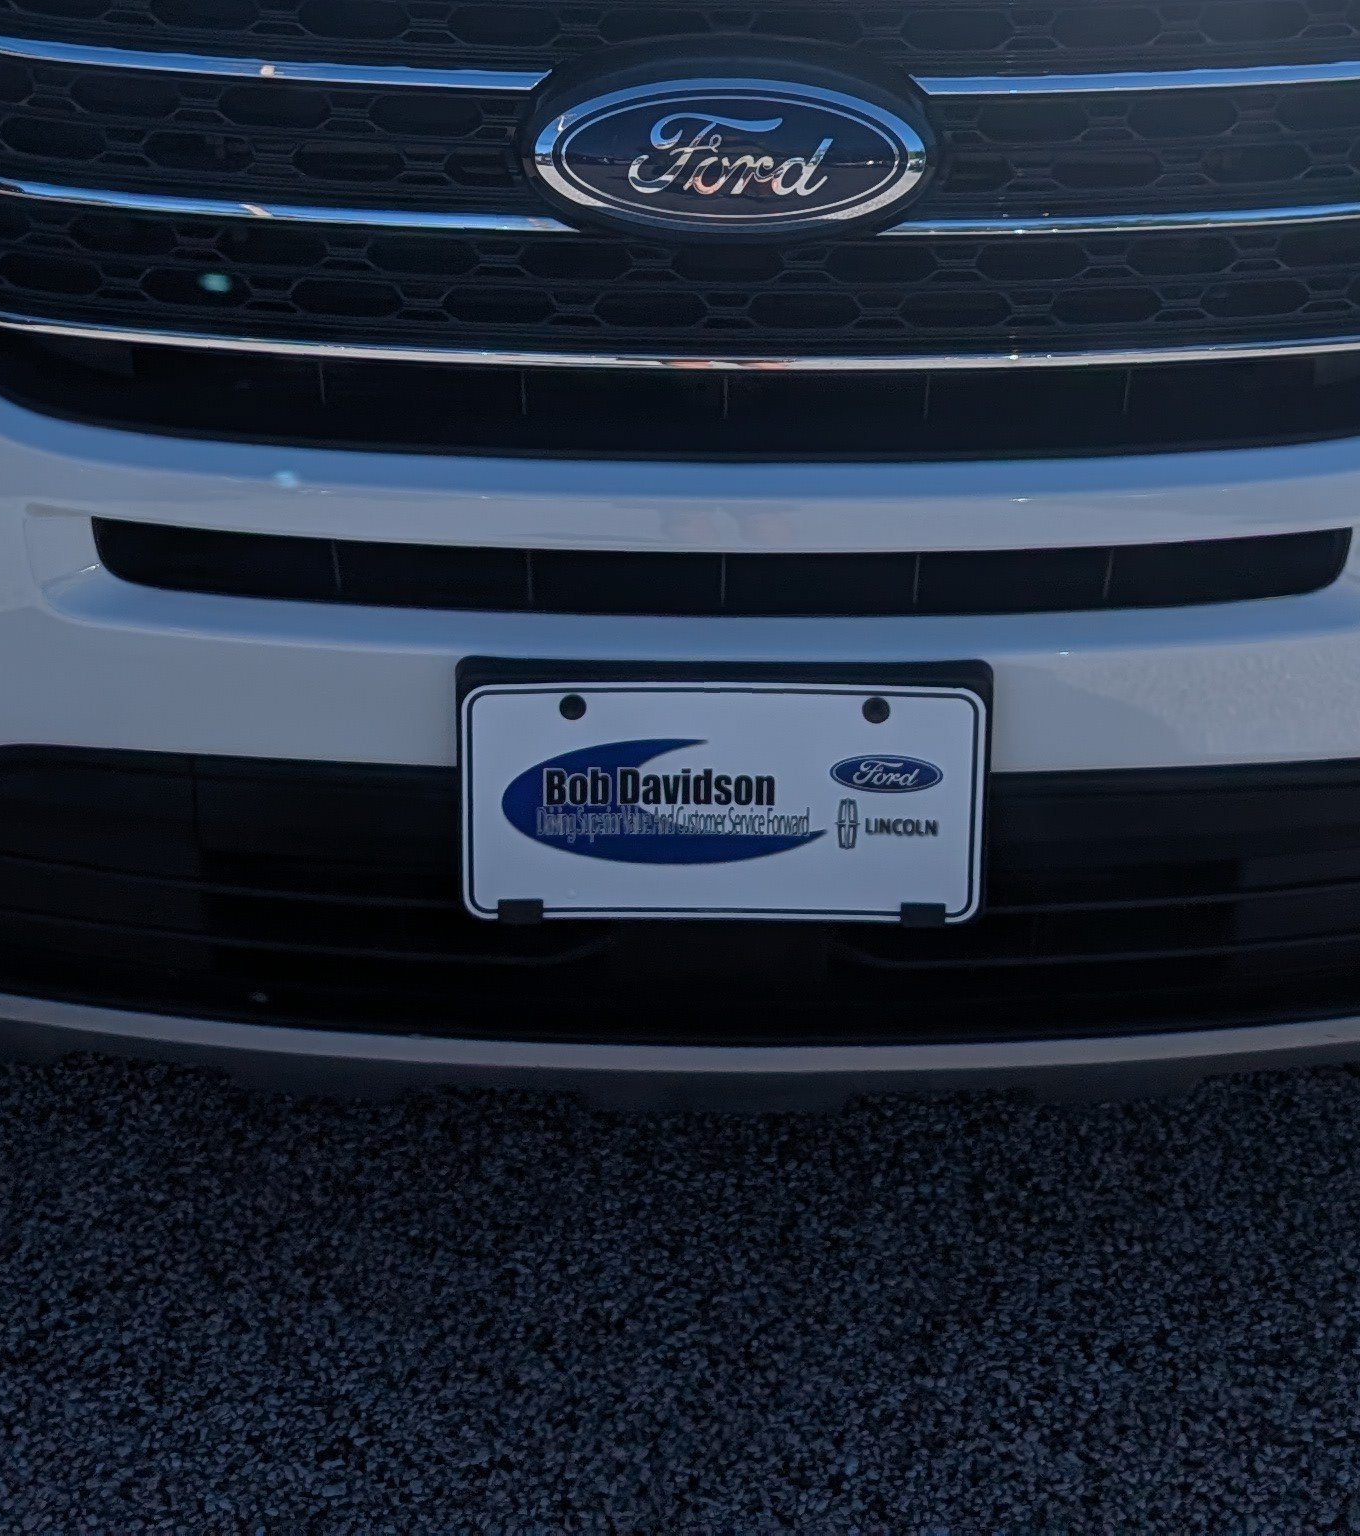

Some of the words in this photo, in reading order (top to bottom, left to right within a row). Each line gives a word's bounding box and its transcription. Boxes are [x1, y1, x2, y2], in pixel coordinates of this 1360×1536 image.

[628, 112, 834, 196] Ford
[545, 767, 613, 807] Bob
[618, 767, 776, 807] Davidson
[852, 760, 920, 787] Ford
[675, 805, 727, 835] Customer
[728, 806, 766, 835] Service
[767, 806, 810, 836] Forward
[864, 817, 939, 837] LINCOLN
